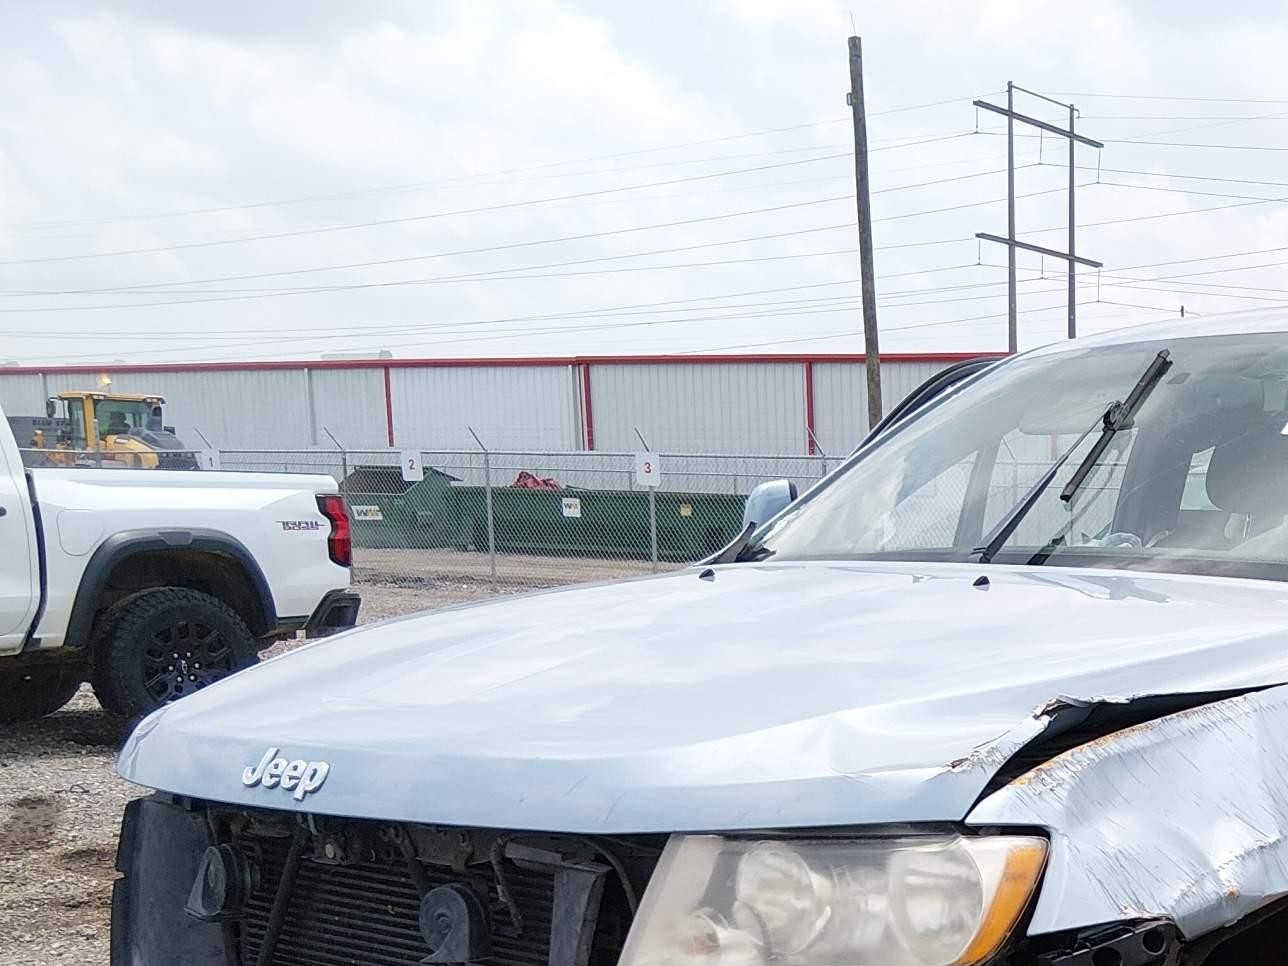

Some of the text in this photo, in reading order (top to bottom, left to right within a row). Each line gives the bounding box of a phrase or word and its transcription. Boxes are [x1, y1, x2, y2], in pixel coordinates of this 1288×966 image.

[208, 456, 214, 468] 1
[408, 458, 416, 470] 2
[644, 461, 652, 474] 3
[242, 747, 331, 802] Jeep
